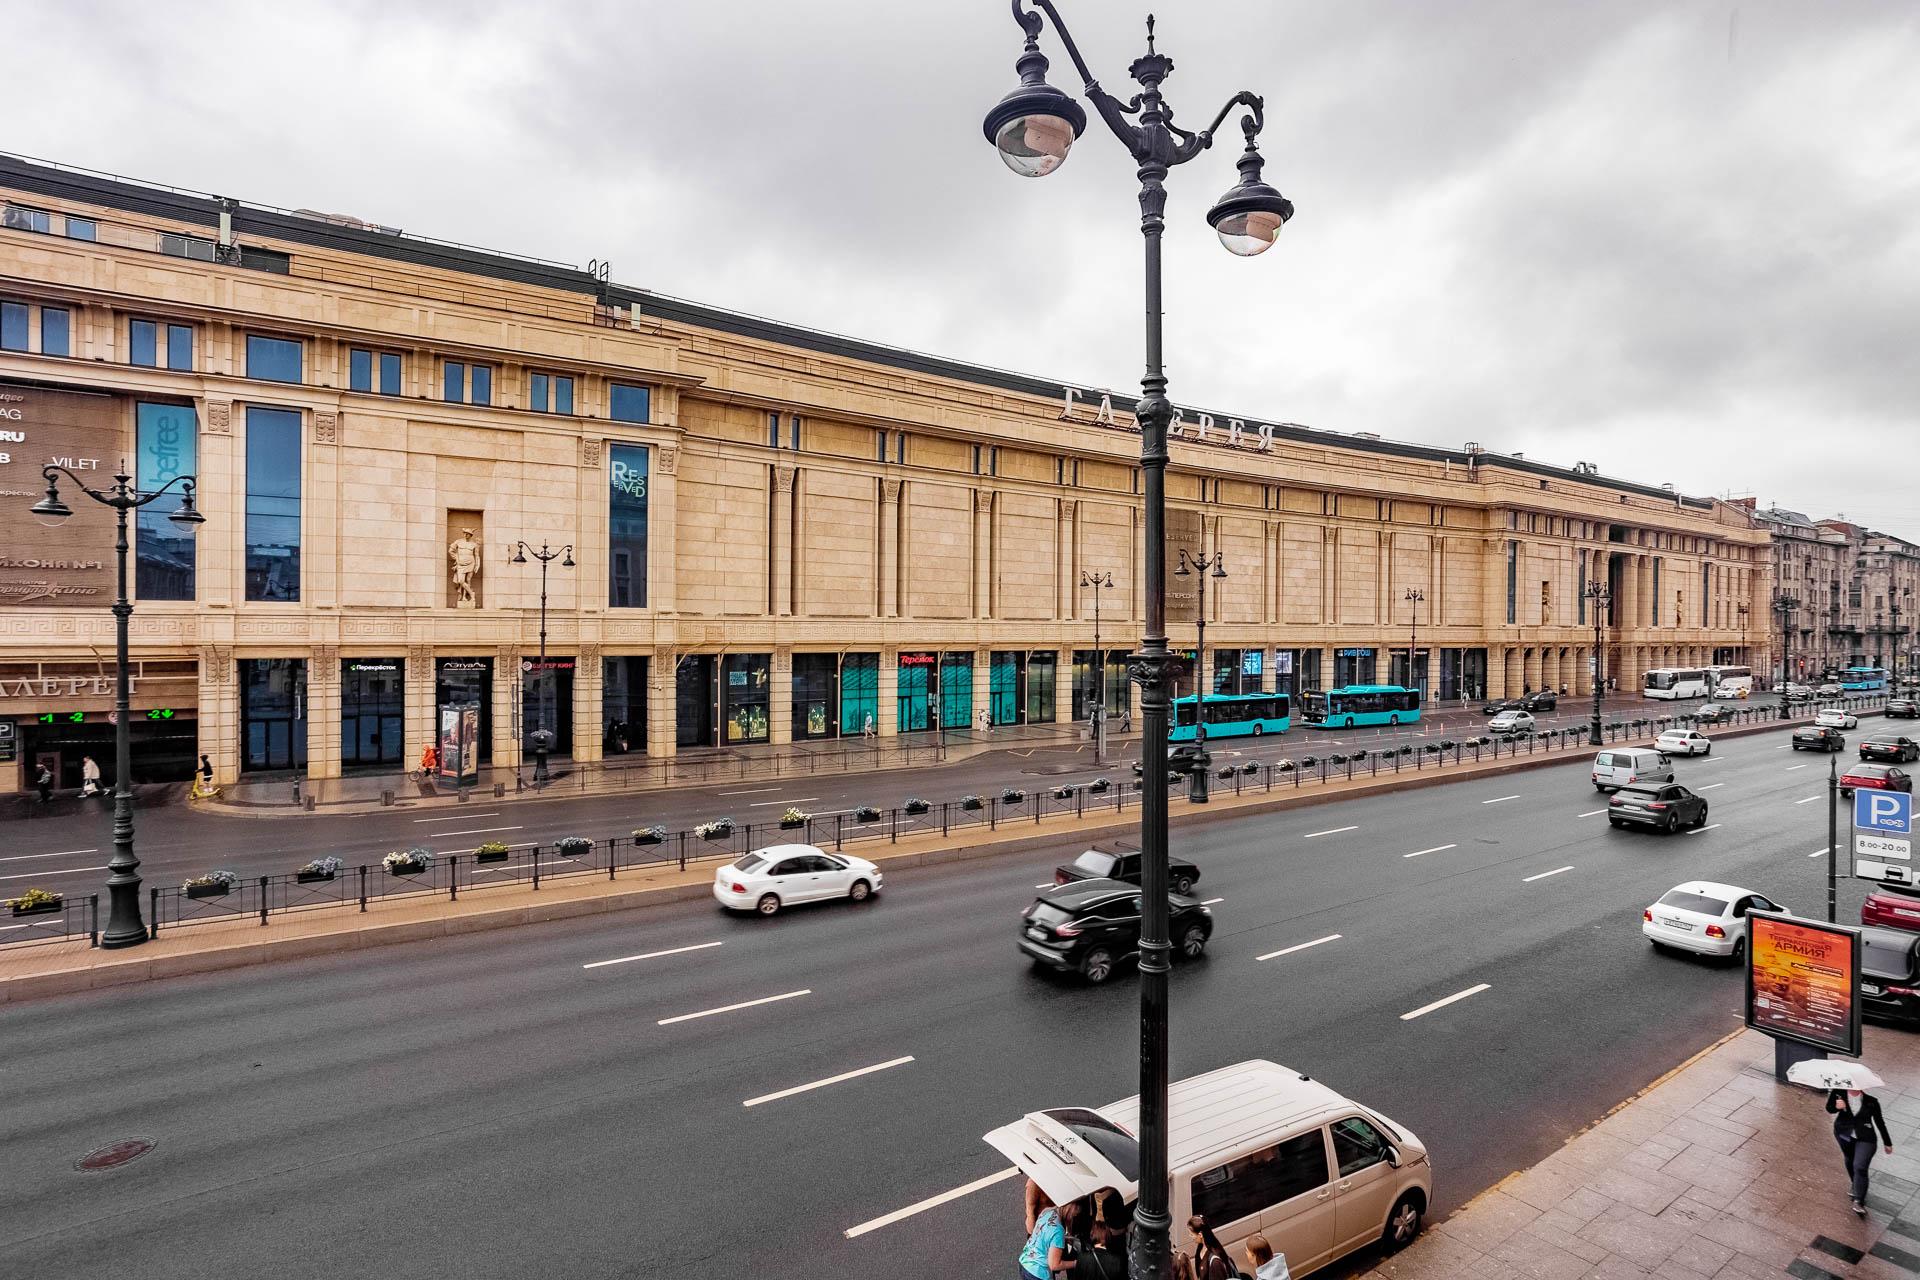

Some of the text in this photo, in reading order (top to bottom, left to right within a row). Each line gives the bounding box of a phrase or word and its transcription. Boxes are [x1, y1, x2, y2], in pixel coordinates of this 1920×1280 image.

[1060, 387, 1275, 450] ГАЕРЕЯ
[149, 416, 179, 484] befree
[1871, 795, 1900, 825] P
[1775, 941, 1825, 959] АРМИЯ
